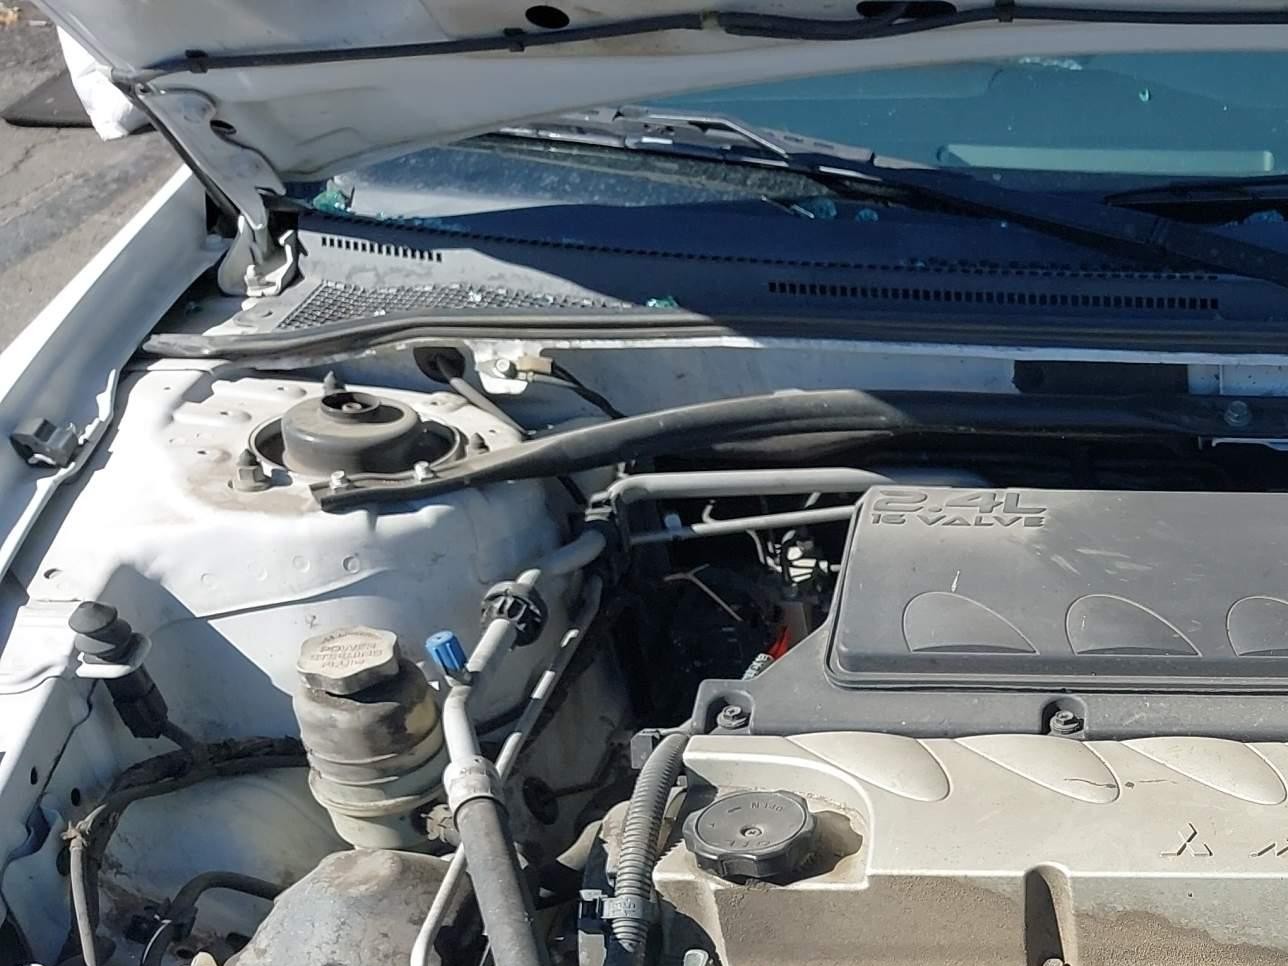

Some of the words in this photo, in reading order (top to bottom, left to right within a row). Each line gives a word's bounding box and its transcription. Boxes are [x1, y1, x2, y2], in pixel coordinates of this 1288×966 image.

[873, 490, 1048, 514] 2.4L
[872, 513, 906, 525] 16
[917, 515, 1046, 527] VALVE
